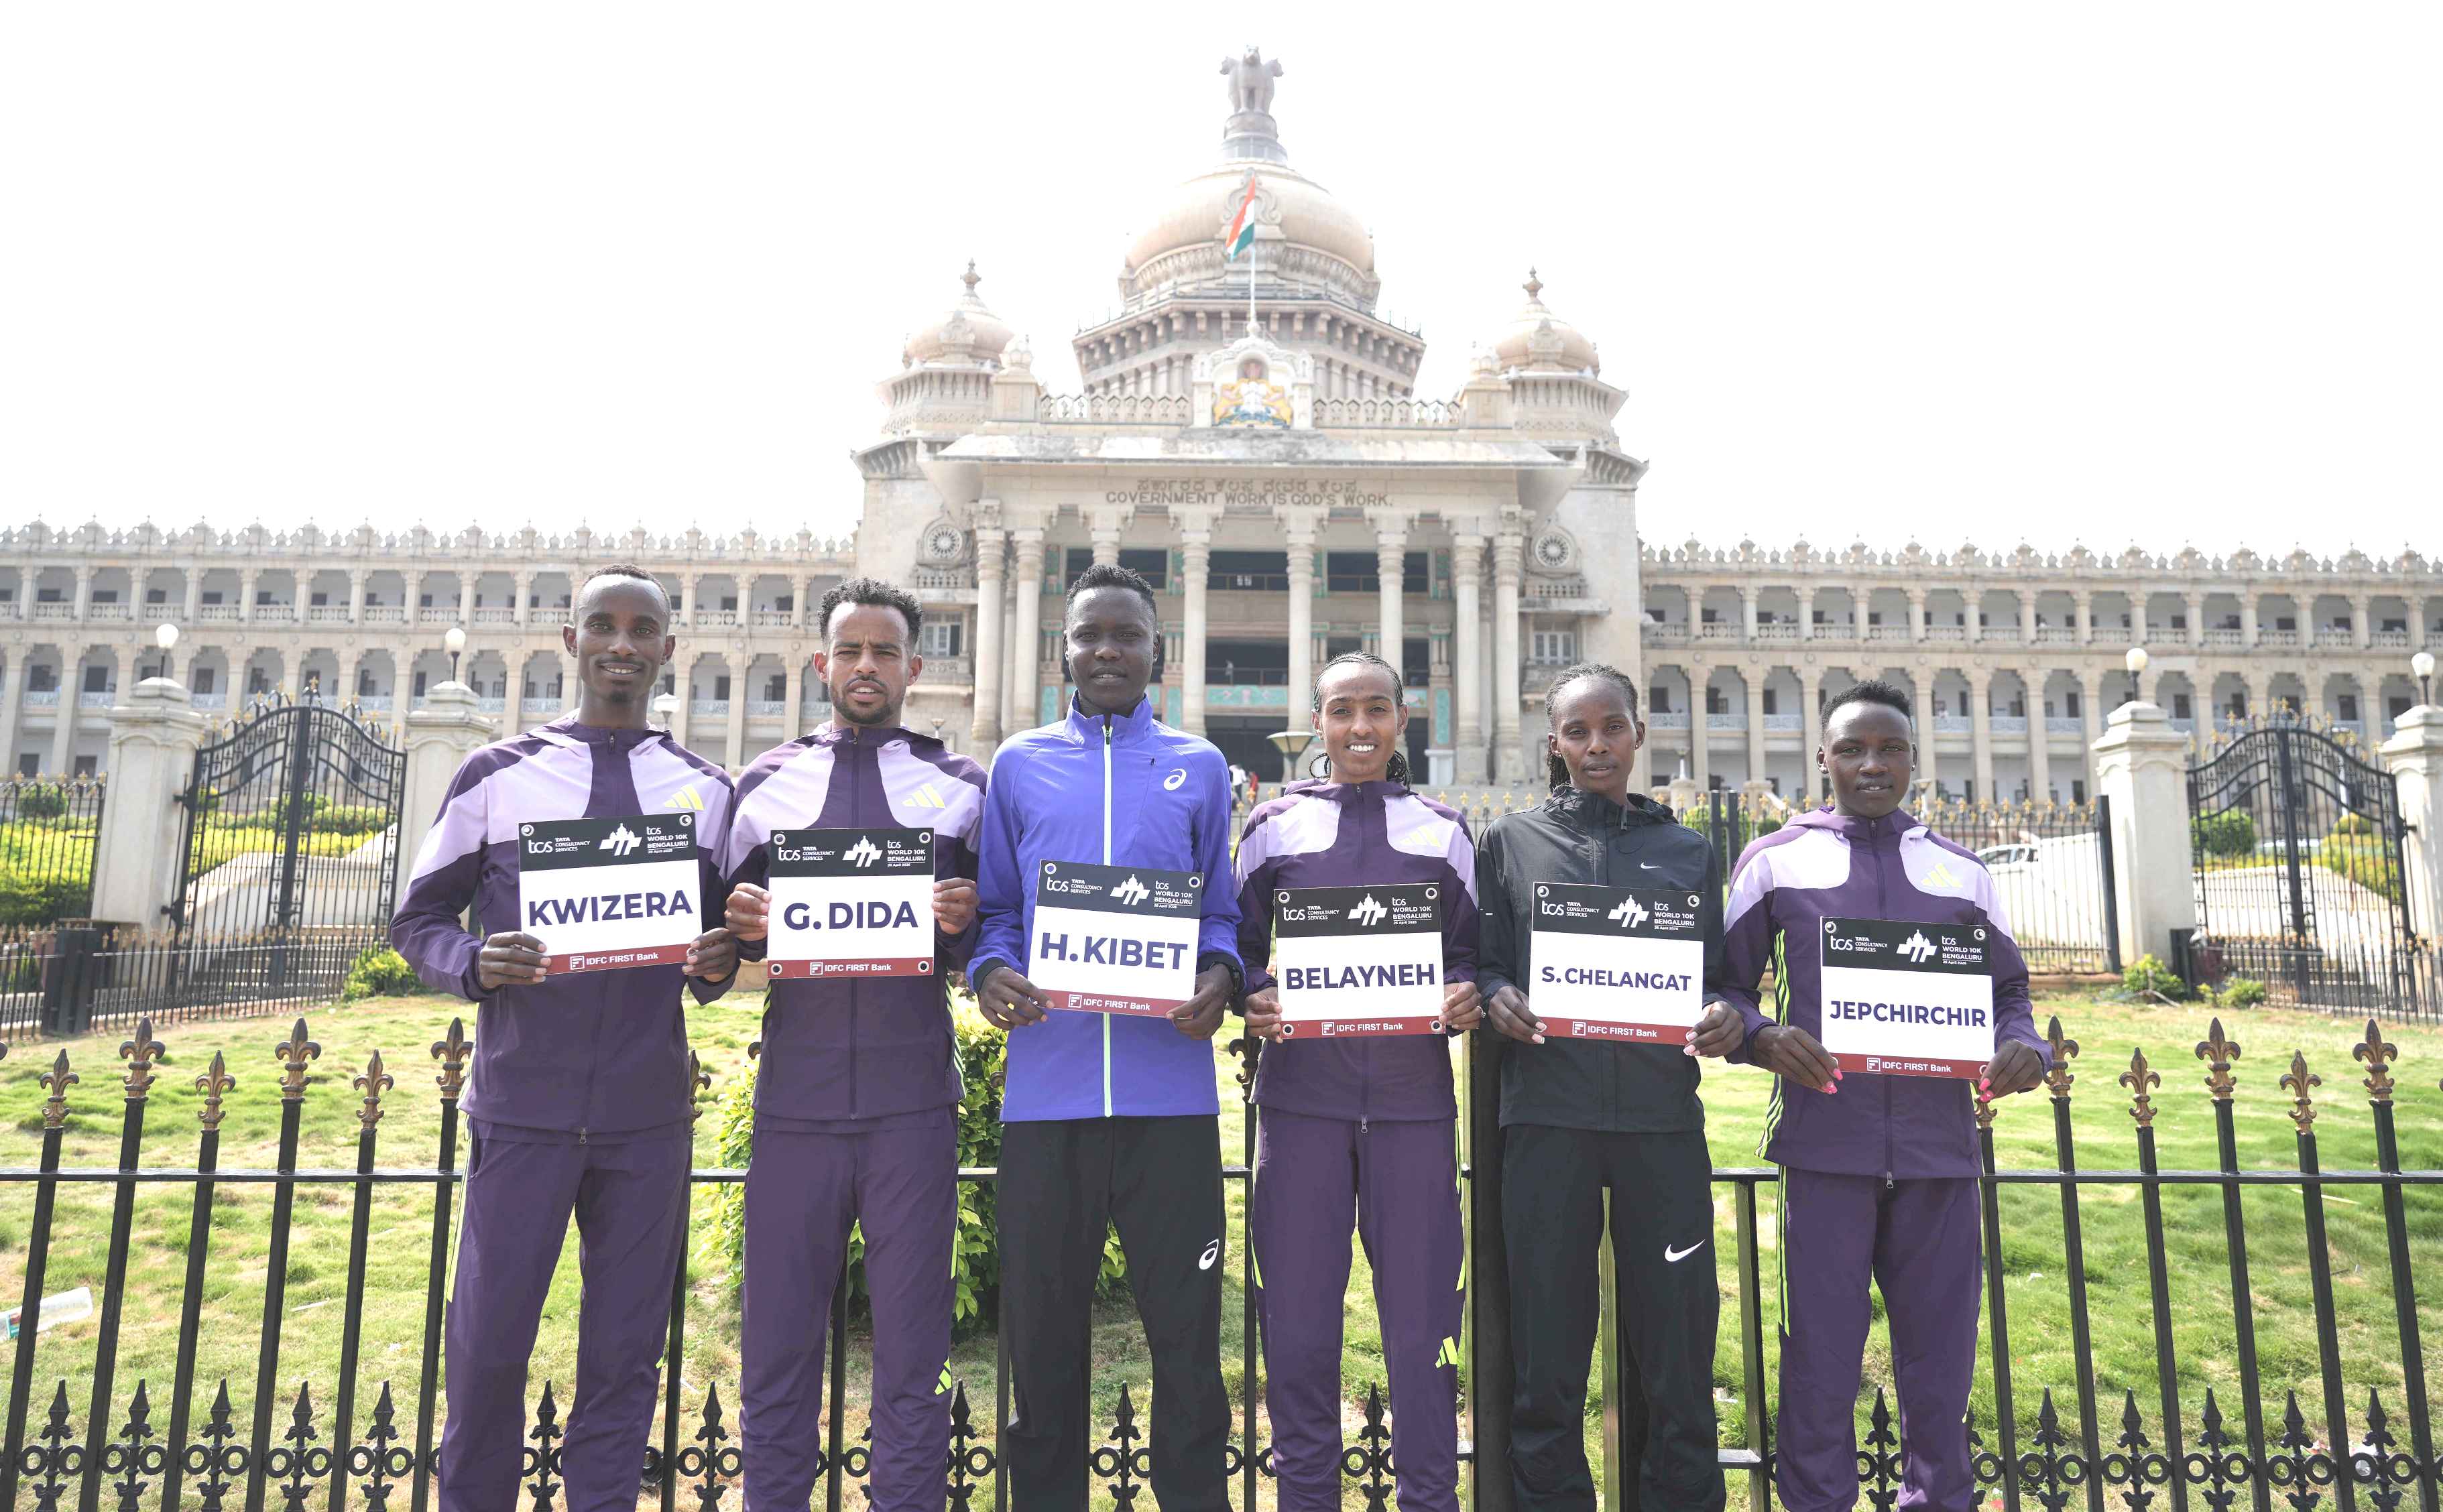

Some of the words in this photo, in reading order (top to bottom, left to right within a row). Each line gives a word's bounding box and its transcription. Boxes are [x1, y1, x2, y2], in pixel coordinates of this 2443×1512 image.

[1106, 491, 1217, 503] GOVERNMENT
[1225, 493, 1267, 504] WORK
[1273, 493, 1287, 505] IS
[1291, 493, 1336, 505] GOD'S
[646, 826, 662, 835] tcs
[528, 839, 553, 855] tcs
[887, 840, 901, 848] tcs
[778, 846, 800, 861] tcs
[1047, 877, 1069, 892] tcs
[1155, 881, 1169, 890] tcs
[1154, 897, 1193, 905] BENGALURU
[1392, 897, 1407, 906] tcs
[1654, 901, 1669, 911] tcs
[529, 889, 693, 927] KWIZERA
[1283, 907, 1305, 921] tcs
[1542, 900, 1564, 916] tcs
[1830, 936, 1853, 951] tcs
[1942, 936, 1956, 945] tcs
[586, 956, 607, 965] IDFC
[609, 954, 634, 963] FIRST
[638, 952, 659, 960] Bank
[1286, 963, 1435, 990] BELAYNEH
[1083, 999, 1103, 1007] IDFC
[1104, 1000, 1129, 1008] FIRST
[1130, 1002, 1150, 1011] Bank
[1830, 1000, 1986, 1027] JEPCHIRCHIR
[1588, 1025, 1607, 1034] IDFC
[1610, 1027, 1634, 1035] FIRST
[1636, 1029, 1657, 1037] Bank
[1882, 1061, 1902, 1070] IDFC
[1904, 1062, 1928, 1071] FIRST
[1930, 1064, 1952, 1072] Bank
